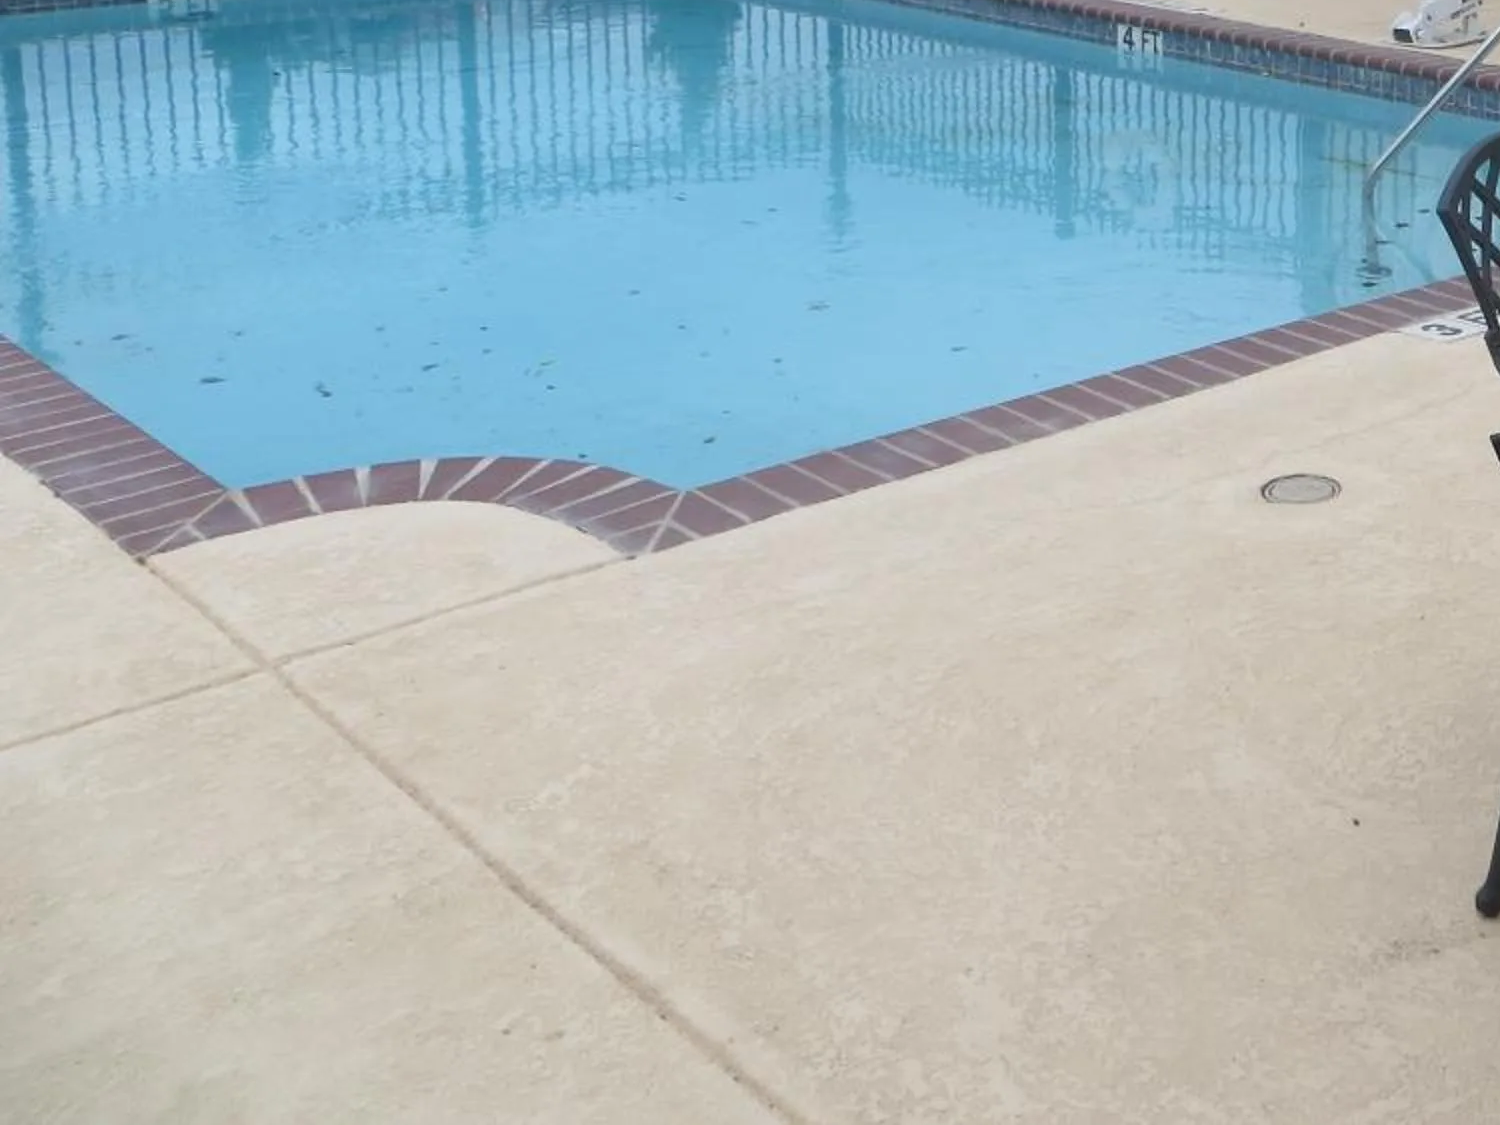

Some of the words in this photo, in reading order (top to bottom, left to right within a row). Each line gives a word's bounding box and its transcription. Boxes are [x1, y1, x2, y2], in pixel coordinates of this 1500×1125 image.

[1123, 26, 1136, 51] 4
[1141, 29, 1161, 55] FT
[1420, 323, 1465, 337] 3
